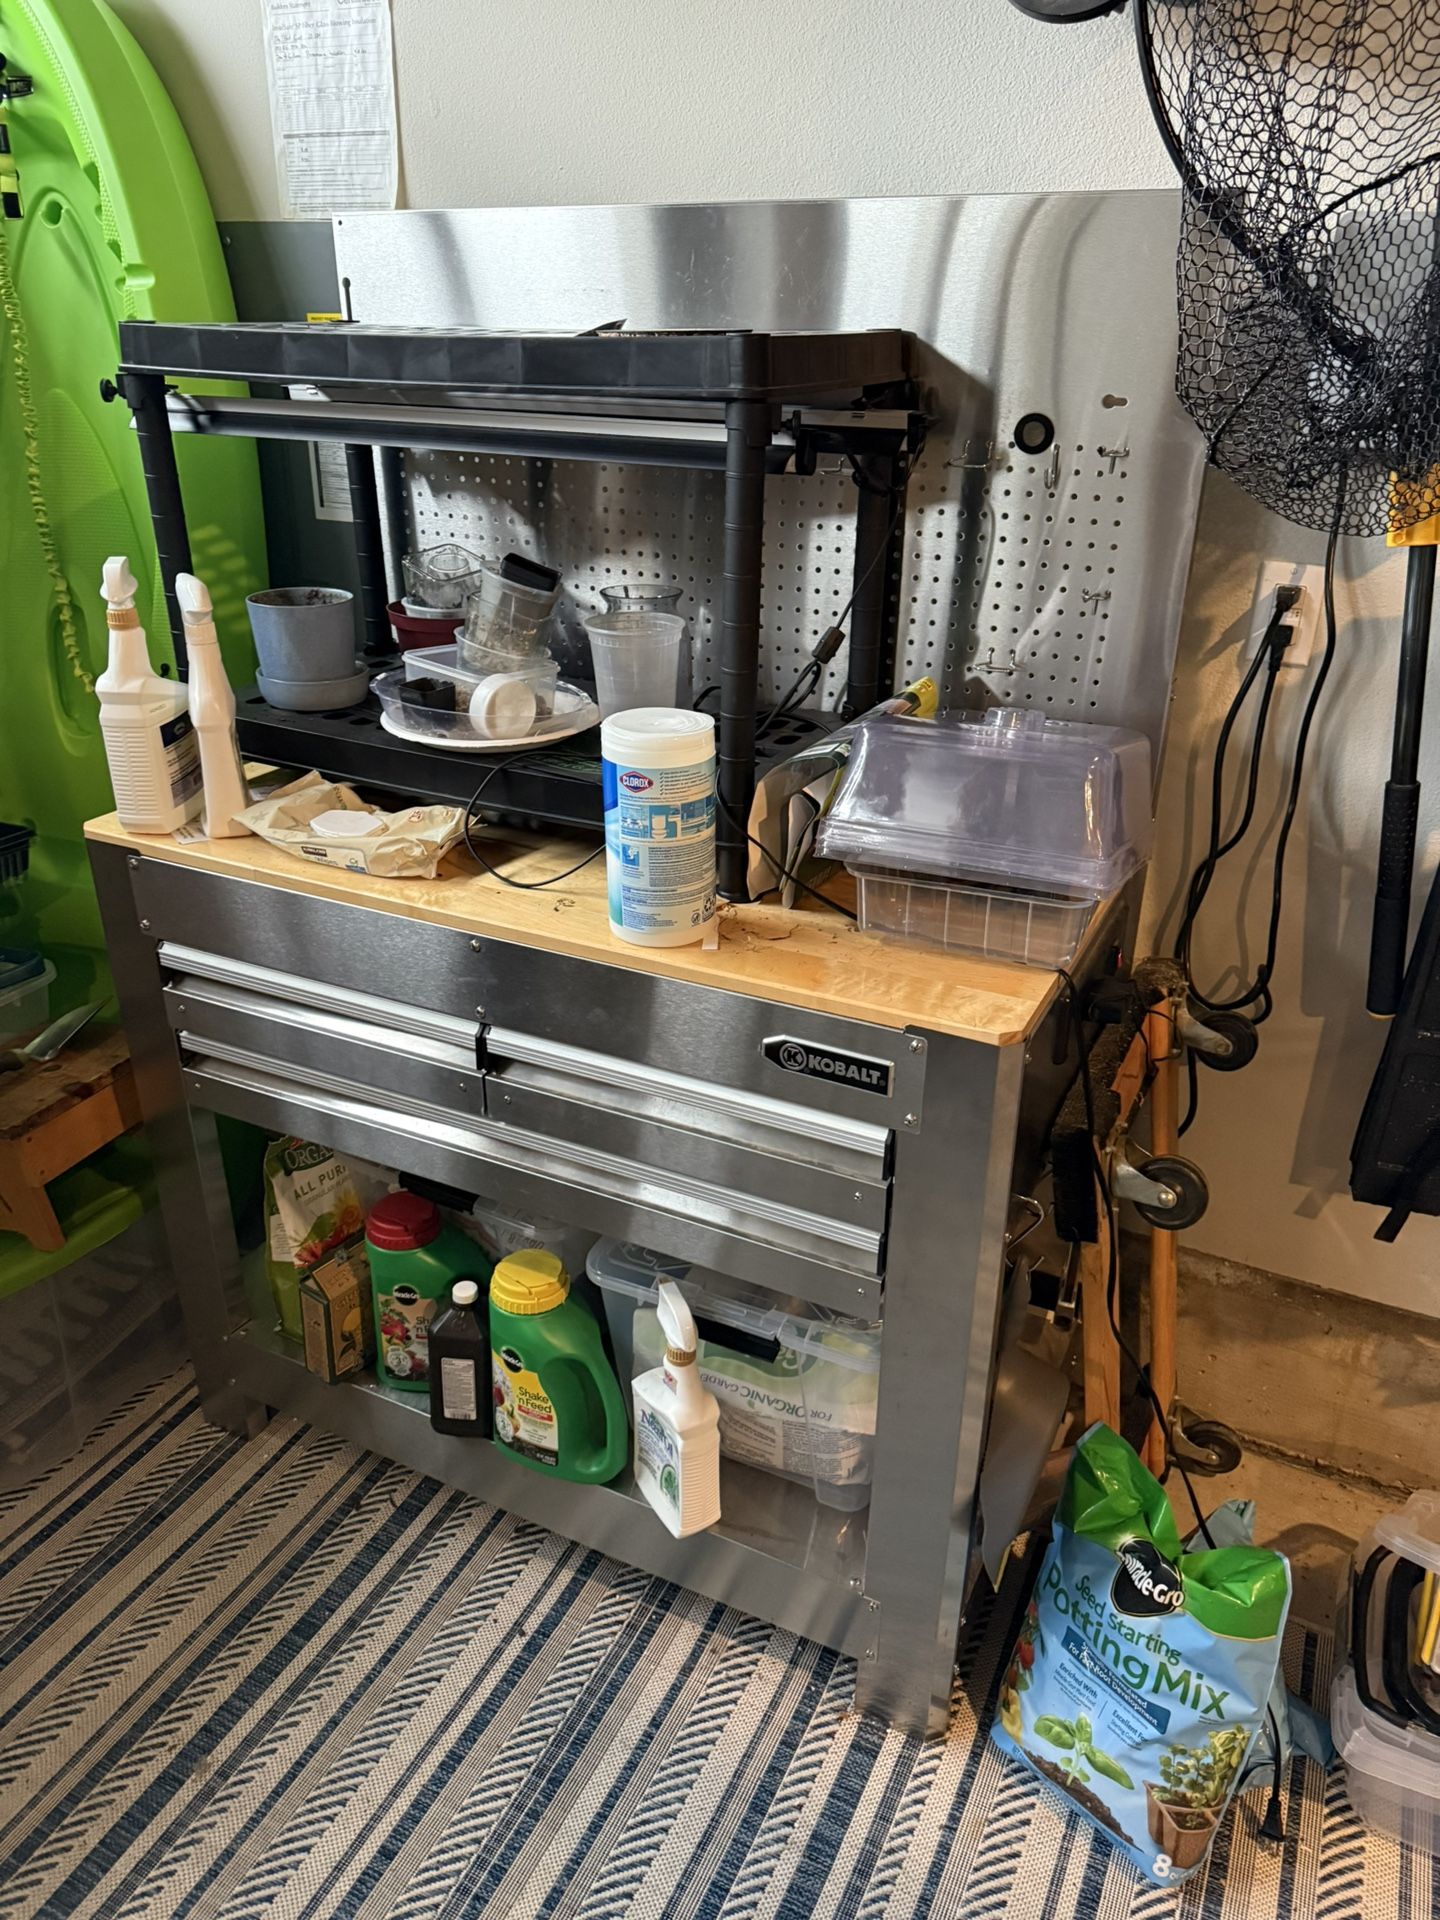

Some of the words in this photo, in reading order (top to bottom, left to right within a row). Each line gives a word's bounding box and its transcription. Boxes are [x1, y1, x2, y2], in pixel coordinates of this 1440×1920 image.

[622, 775, 649, 788] CLOROX
[808, 1054, 881, 1085] KOBALT
[293, 1181, 316, 1201] ALL
[518, 1386, 549, 1404] Shake
[699, 1373, 739, 1393] GARDE
[526, 1398, 552, 1414] Feed
[740, 1385, 806, 1418] ORGANIC
[810, 1409, 833, 1421] FOR
[1075, 1575, 1107, 1619] Seed
[1107, 1613, 1182, 1667] Starting
[1042, 1561, 1150, 1690] Potting
[1152, 1661, 1230, 1720] Mix
[1059, 1662, 1084, 1687] Enriched
[1082, 1682, 1098, 1699] With
[1111, 1680, 1158, 1727] Development
[1112, 1709, 1138, 1736] Excellent
[1152, 1853, 1173, 1878] 8
